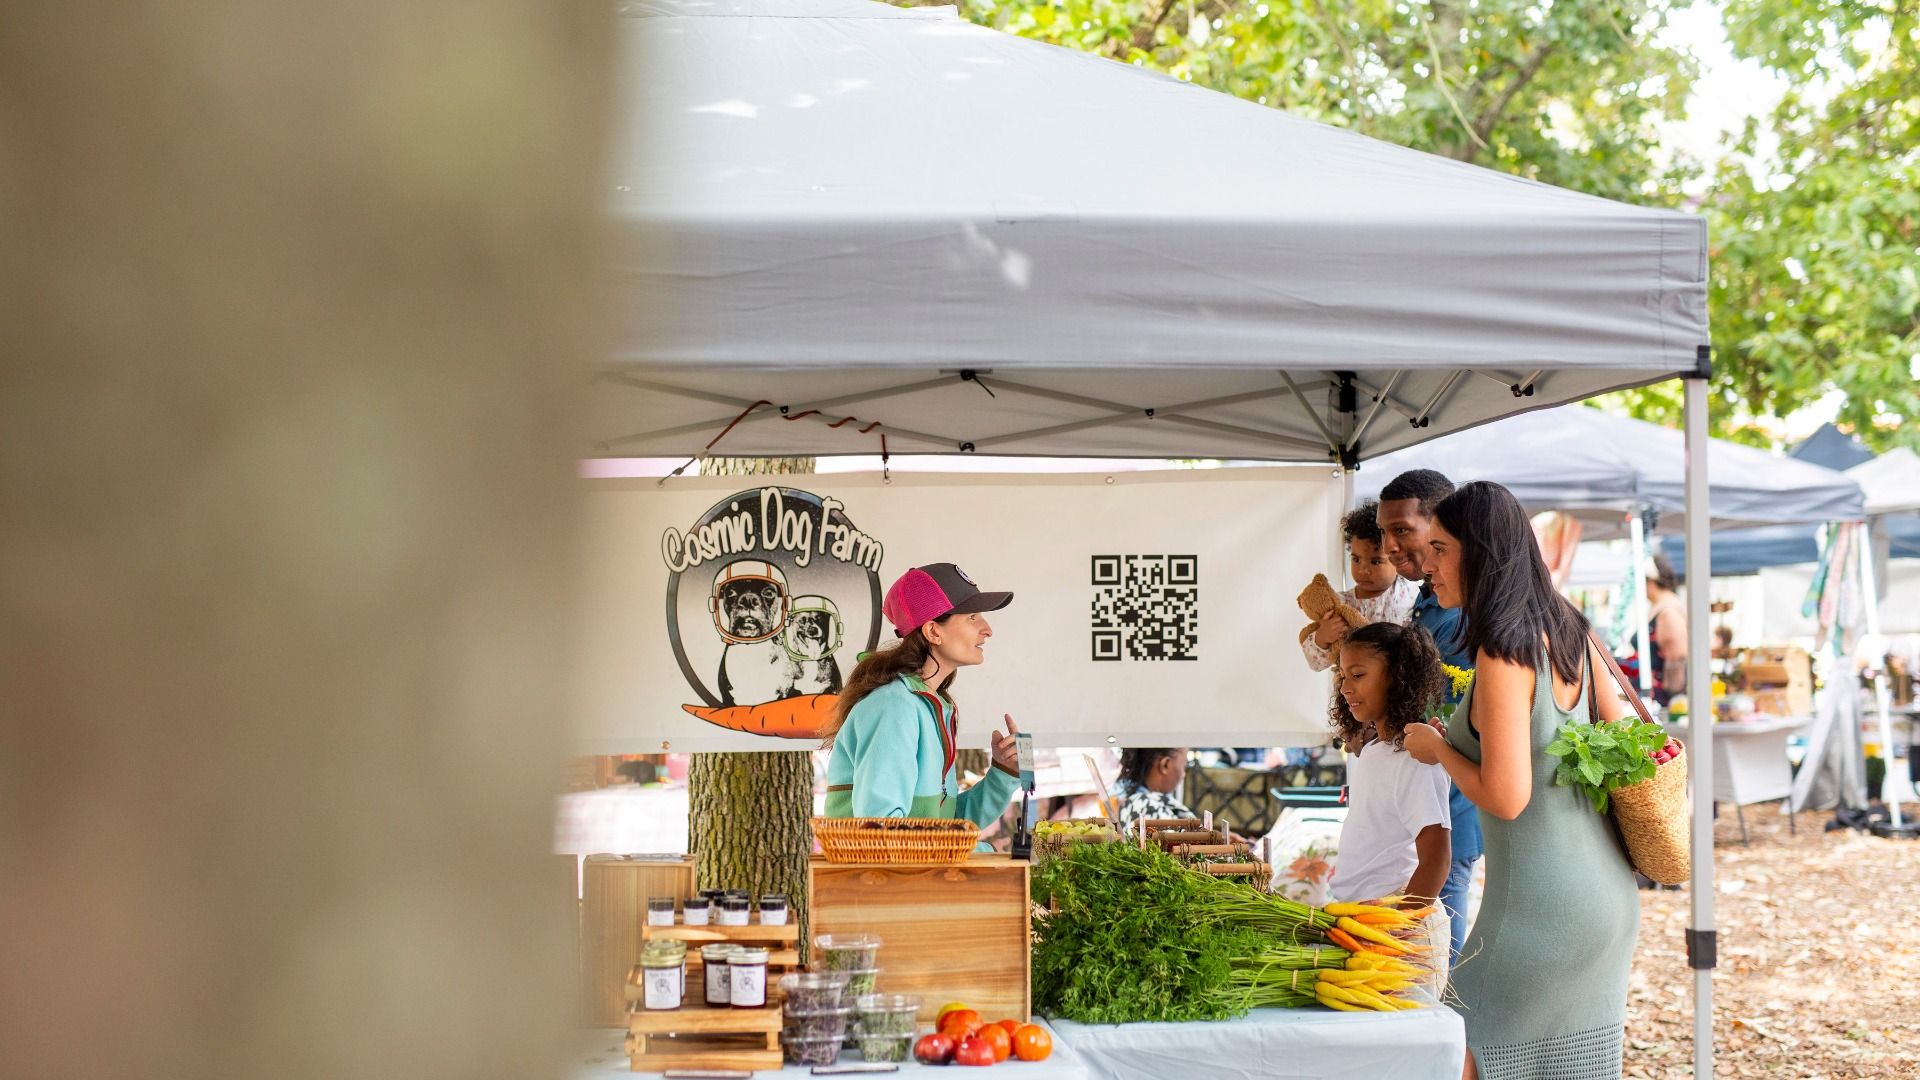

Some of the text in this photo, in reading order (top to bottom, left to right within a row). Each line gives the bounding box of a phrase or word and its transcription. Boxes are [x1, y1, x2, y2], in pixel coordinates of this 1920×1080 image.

[661, 487, 883, 572] Cosmic Dog Farm
